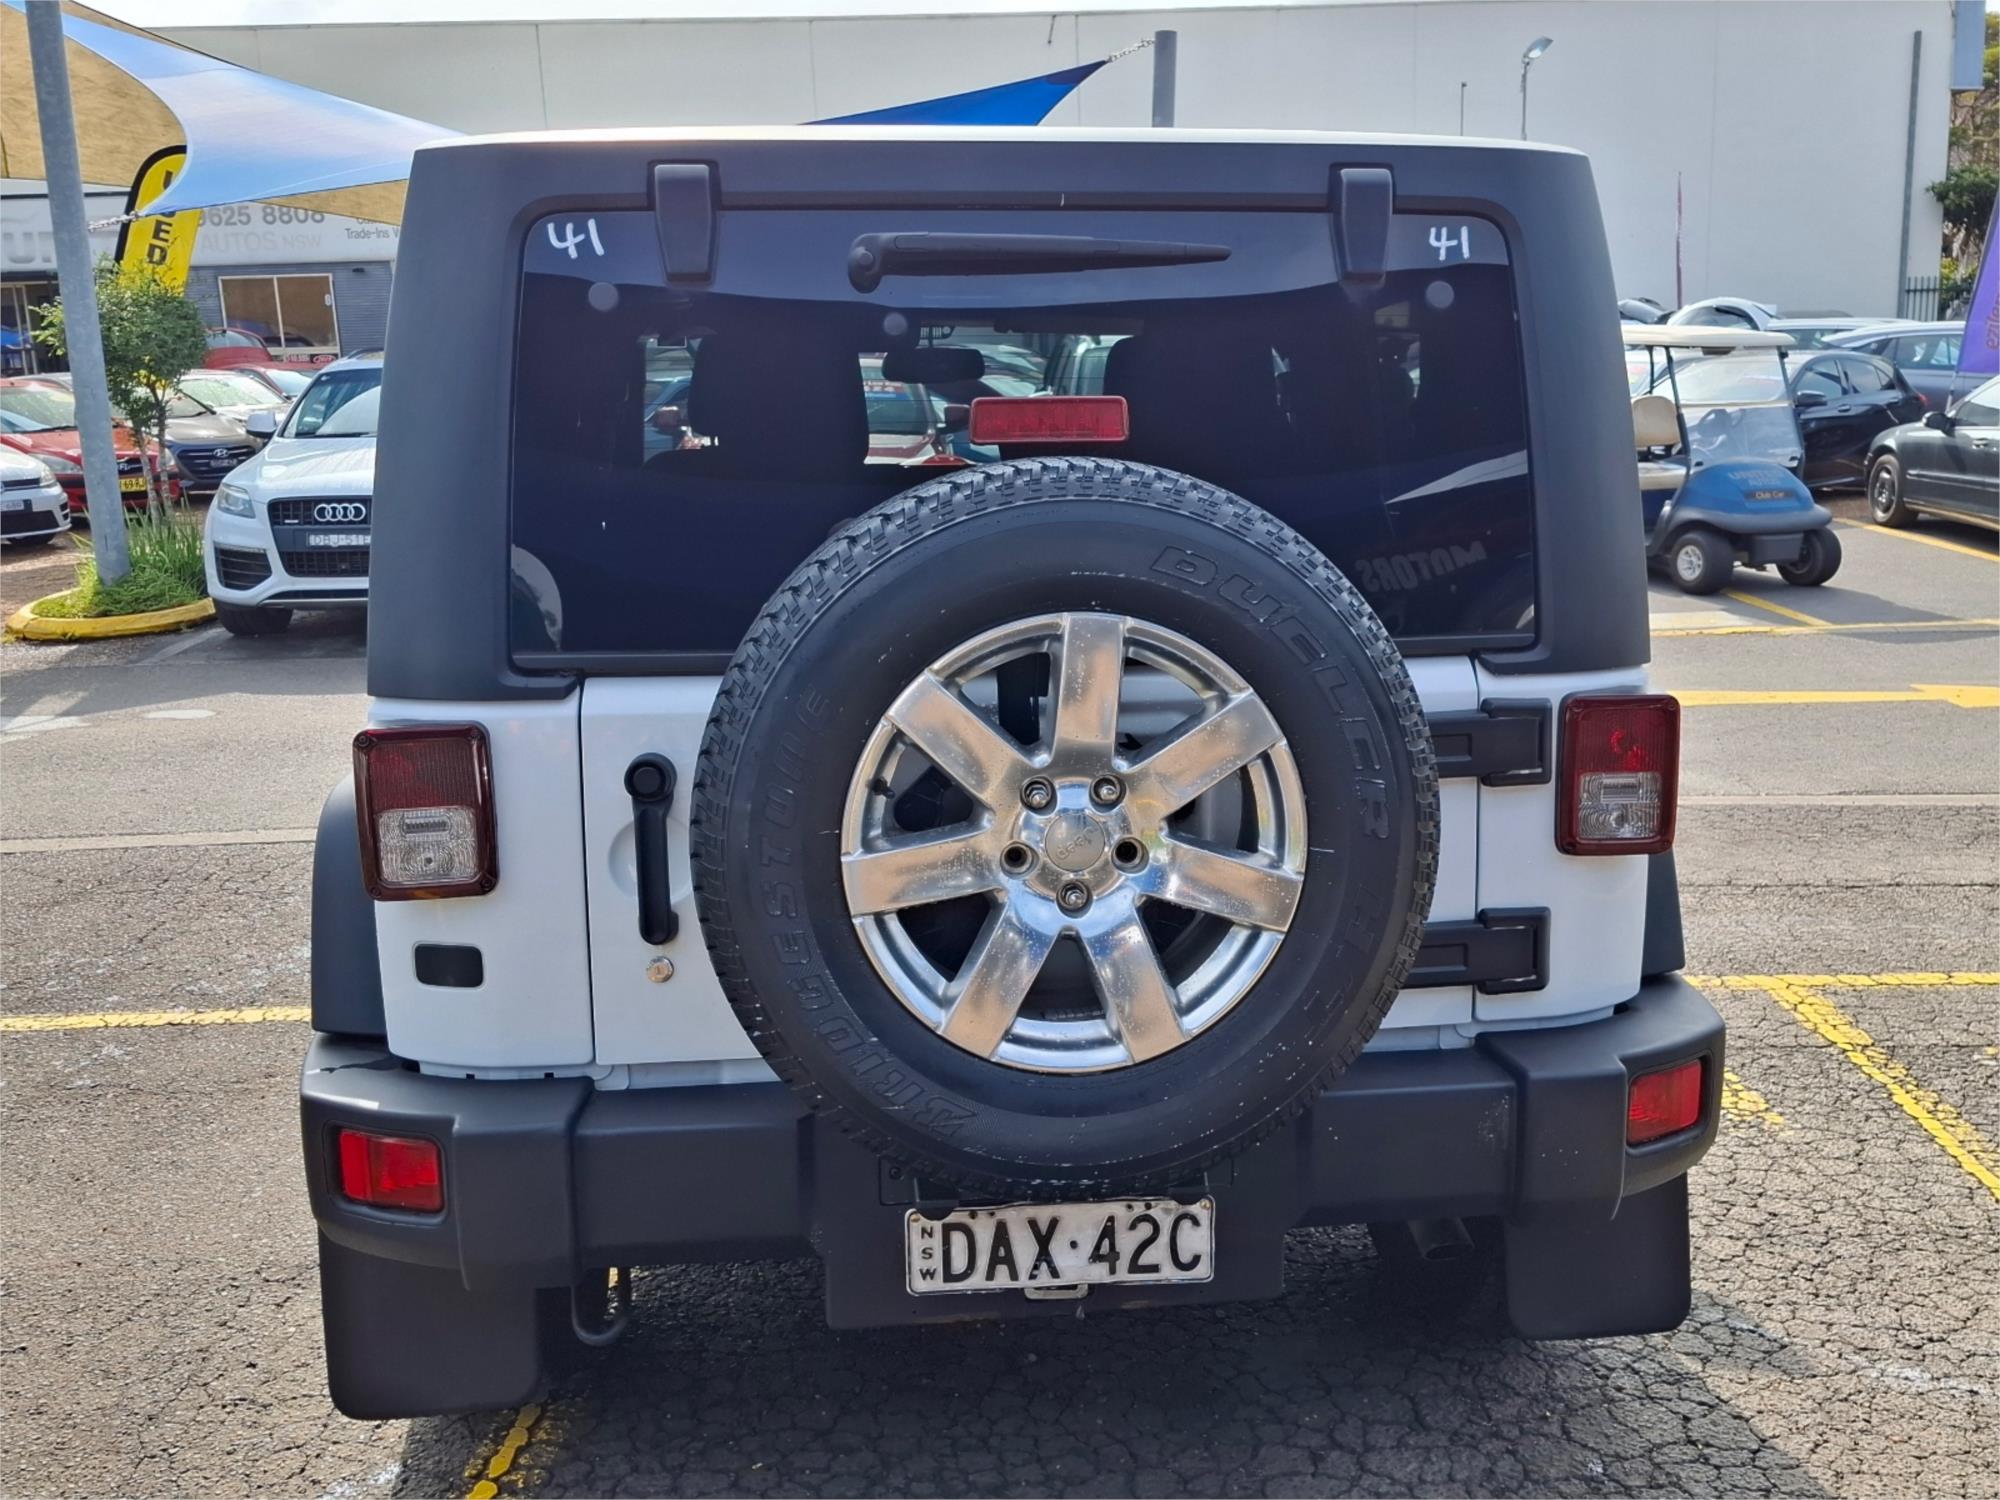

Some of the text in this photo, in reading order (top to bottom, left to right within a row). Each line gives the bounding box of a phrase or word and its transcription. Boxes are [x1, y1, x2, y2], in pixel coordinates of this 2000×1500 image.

[200, 231, 321, 252] AUTOS NSW
[344, 227, 390, 239] Trade-Ins
[547, 218, 605, 259] 41
[1429, 225, 1472, 262] 41
[1150, 545, 1389, 839] DUELER
